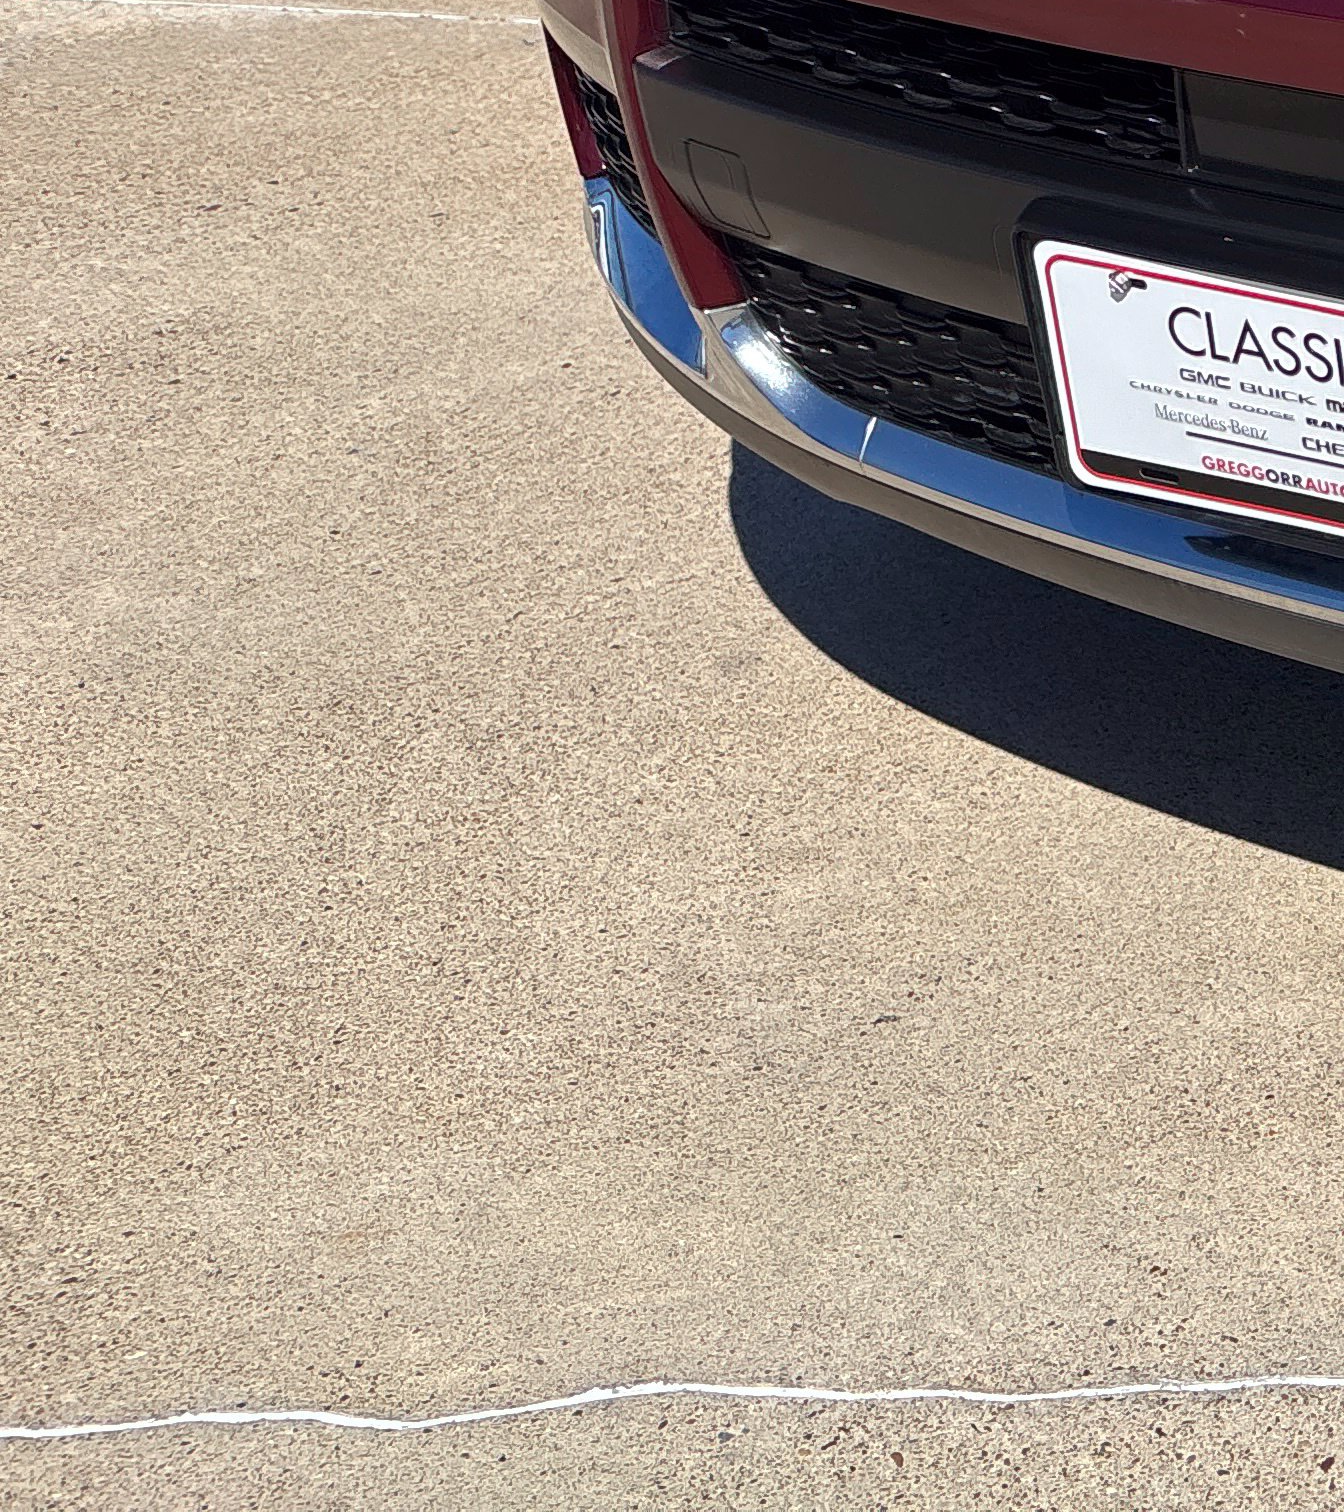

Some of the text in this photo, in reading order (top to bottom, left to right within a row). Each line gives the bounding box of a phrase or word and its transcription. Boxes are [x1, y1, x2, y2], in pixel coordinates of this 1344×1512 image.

[1129, 380, 1218, 405] CHRYSLER
[1228, 401, 1296, 421] DODGE
[1179, 367, 1232, 390] GMC
[1239, 381, 1317, 406] BUICK
[1154, 402, 1269, 441] Mercedes-Benz
